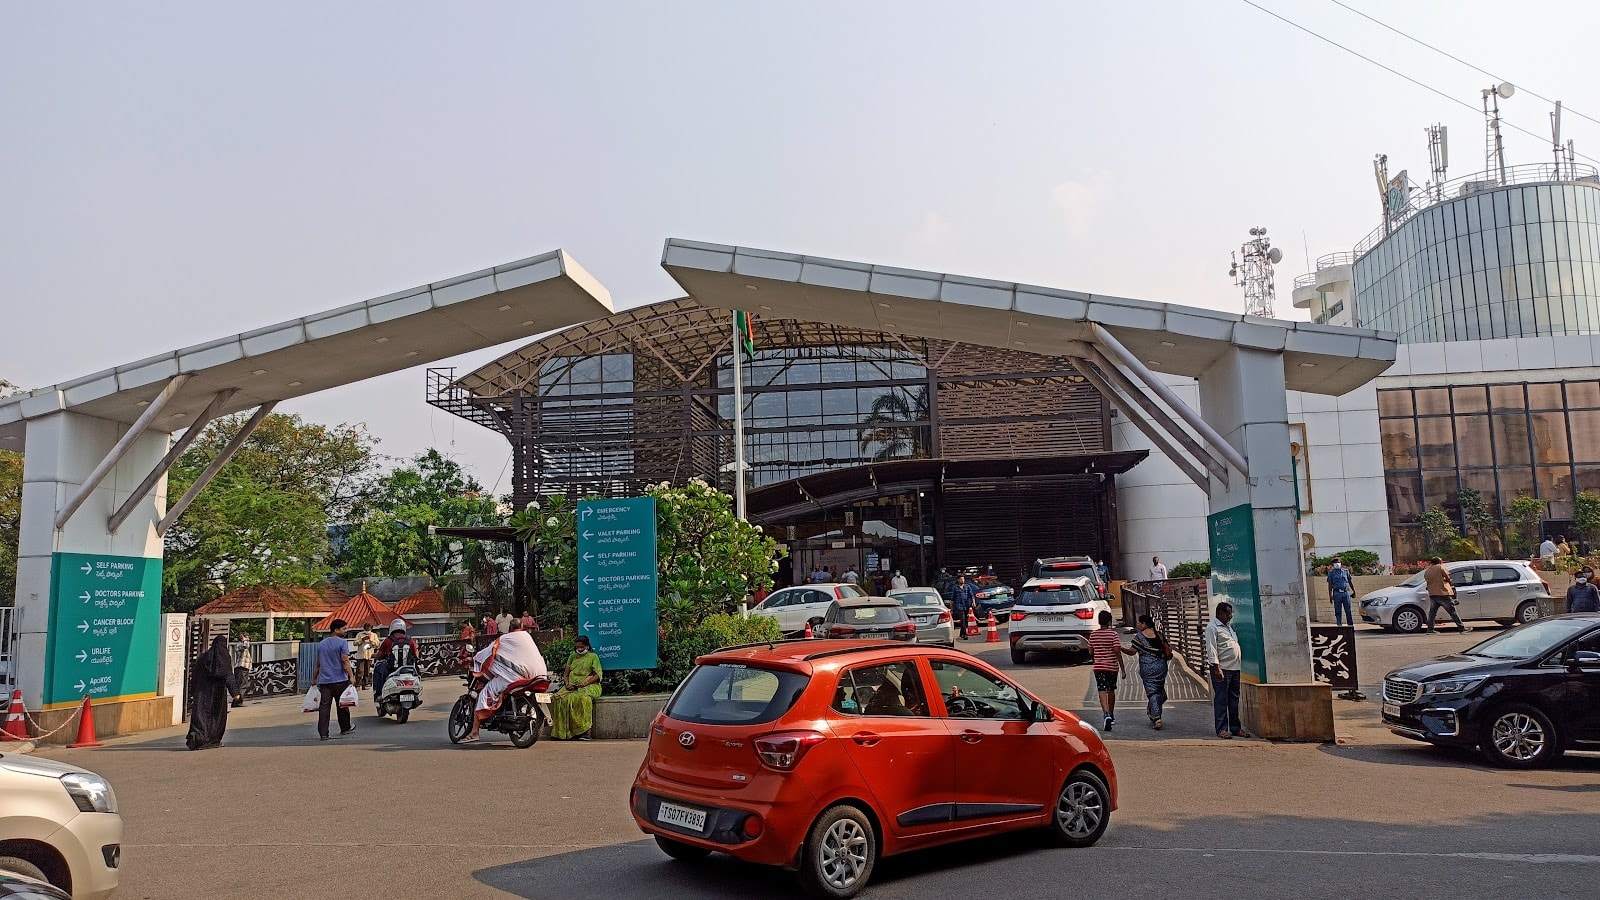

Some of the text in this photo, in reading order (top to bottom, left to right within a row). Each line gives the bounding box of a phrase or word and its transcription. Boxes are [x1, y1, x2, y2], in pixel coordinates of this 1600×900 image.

[597, 506, 631, 514] EMERGENCY
[616, 528, 641, 536] PARKING
[110, 562, 134, 570] PARKING
[597, 575, 625, 583] DOCTORS
[121, 590, 145, 598] PARKING
[93, 618, 116, 626] CANCER
[598, 621, 618, 629] URLIFE
[91, 647, 112, 655] URLIFE
